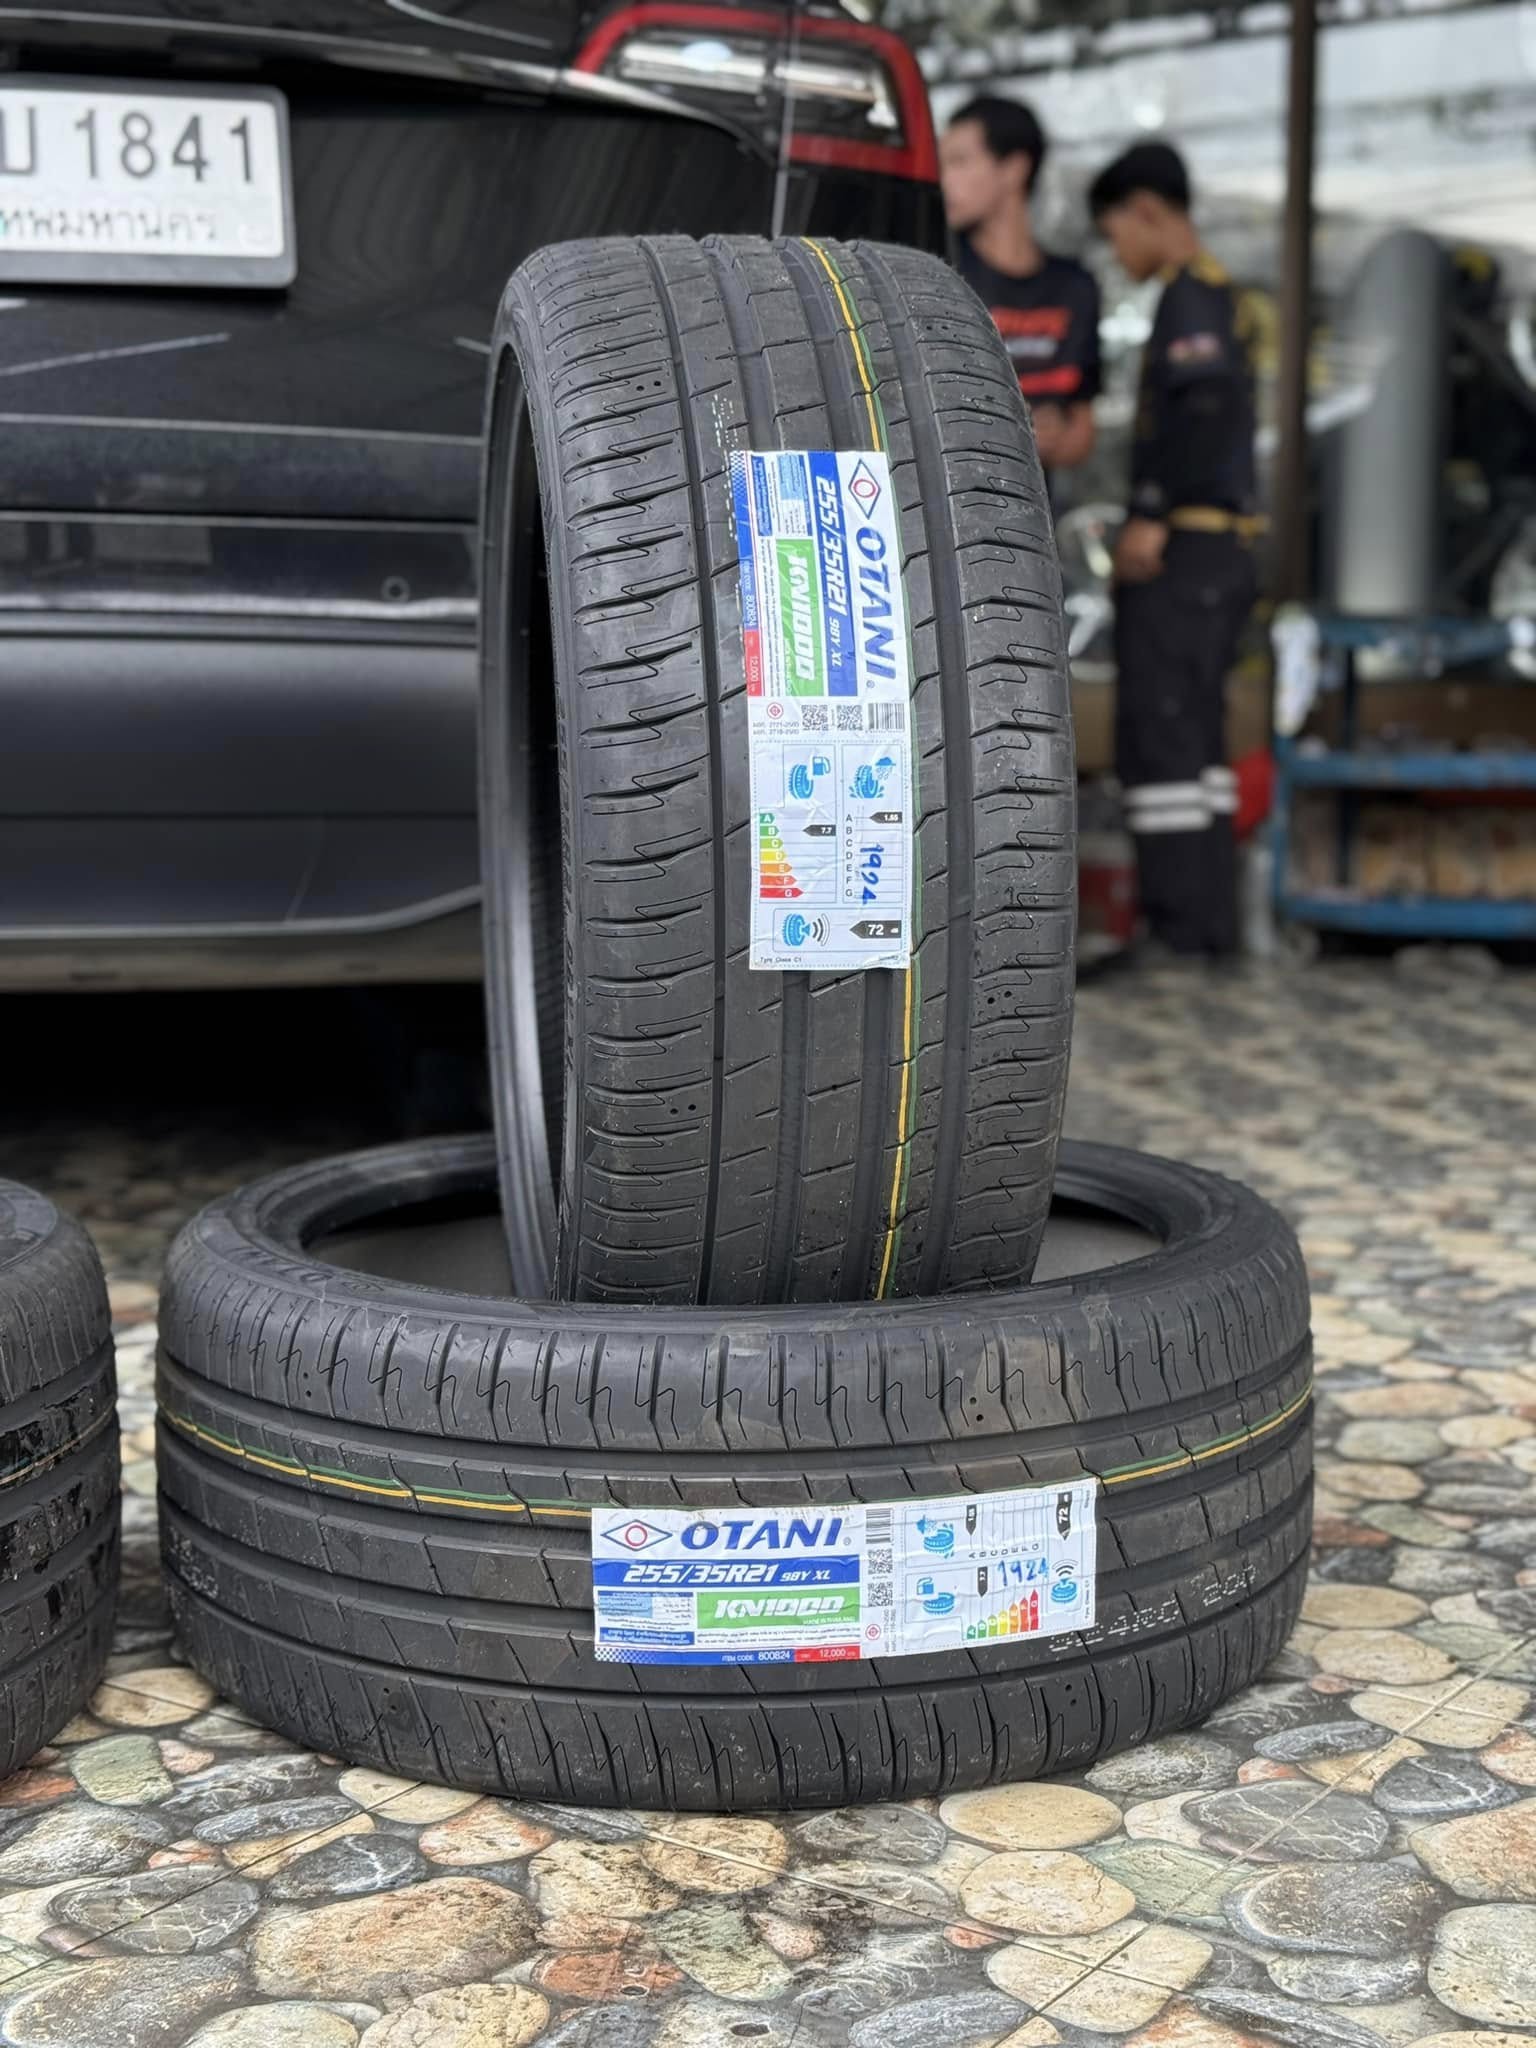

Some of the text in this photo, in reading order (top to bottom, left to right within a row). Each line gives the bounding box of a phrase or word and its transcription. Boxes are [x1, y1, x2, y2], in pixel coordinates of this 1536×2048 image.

[75, 108, 253, 183] 1841
[815, 475, 849, 668] 255/35R21 98Y XL
[745, 595, 757, 627] 800824
[856, 526, 896, 680] OTANI
[787, 556, 815, 681] KN1000
[846, 814, 853, 822] A
[768, 827, 776, 835] B
[846, 839, 852, 847] C
[860, 844, 885, 904] 1924
[784, 889, 793, 897] G
[846, 889, 853, 897] G
[868, 924, 884, 936] 72
[1058, 1507, 1069, 1524] 72
[681, 1518, 844, 1551] OTANI
[622, 1563, 831, 1584] 255/35R21 98Y XL
[998, 1557, 1049, 1587] 1924
[714, 1595, 846, 1619] KN1000
[758, 1650, 791, 1661] 800824
